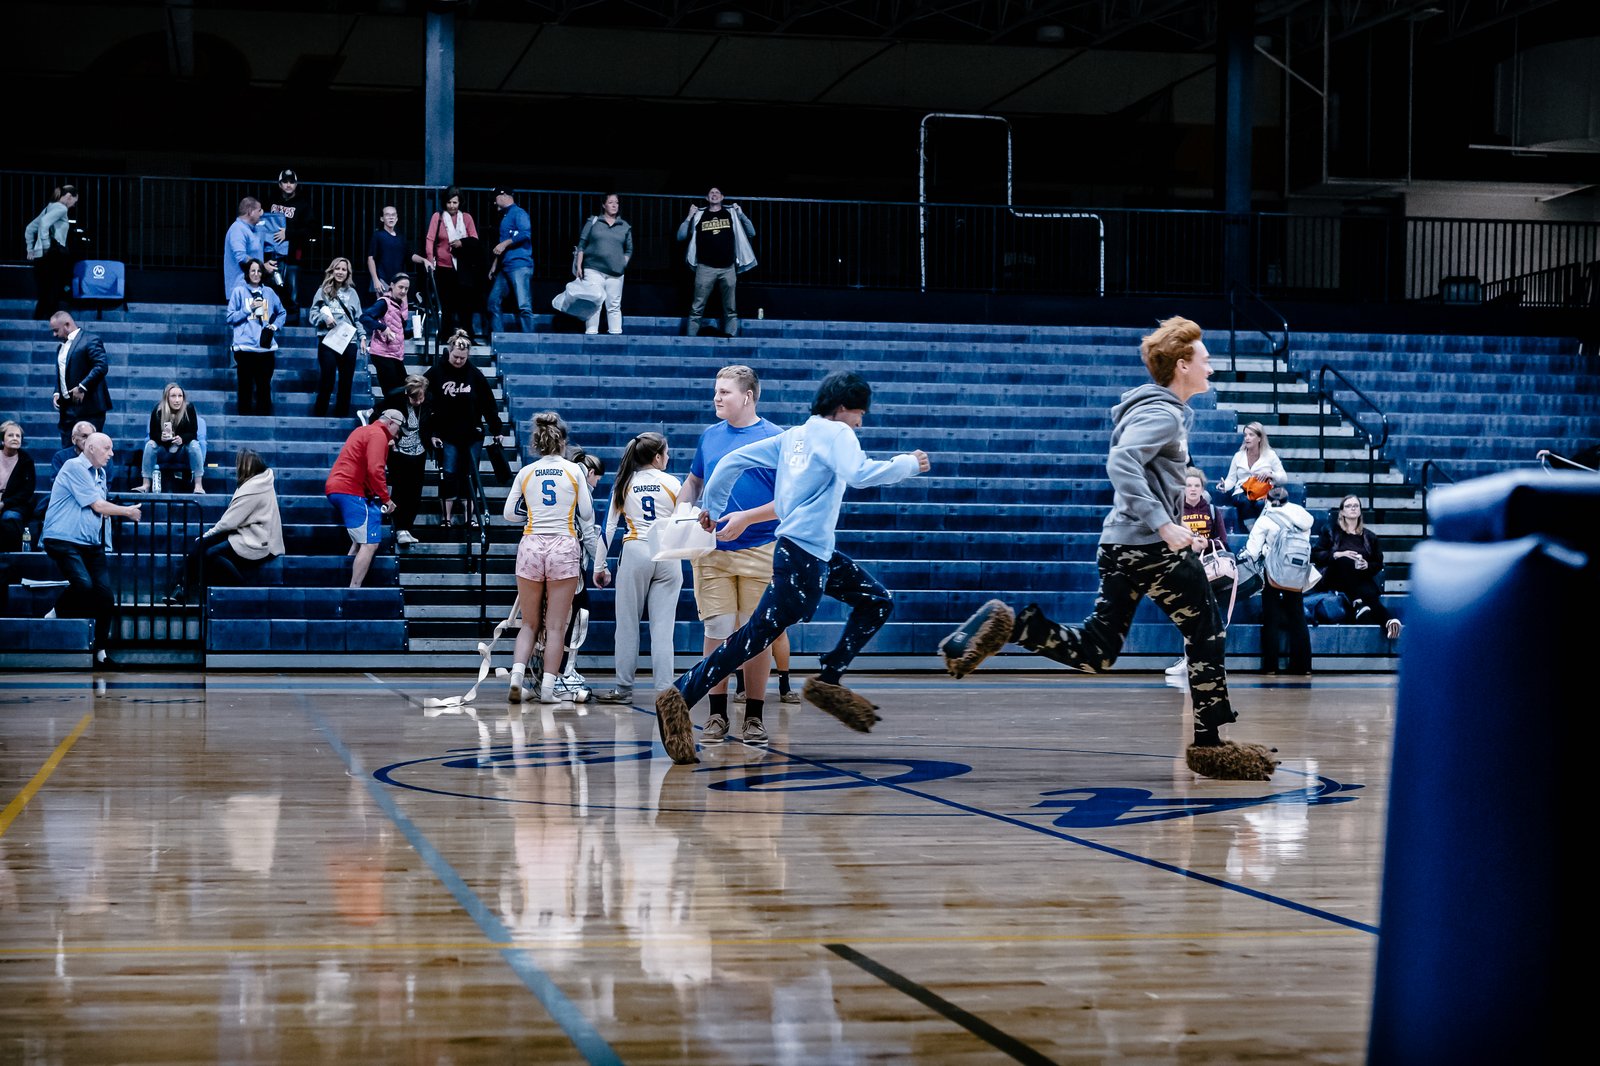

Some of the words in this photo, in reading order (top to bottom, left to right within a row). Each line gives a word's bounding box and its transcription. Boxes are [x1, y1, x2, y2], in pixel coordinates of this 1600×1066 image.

[535, 468, 563, 476] CHARGERS
[633, 485, 661, 493] CHARGERS
[641, 495, 657, 521] 9
